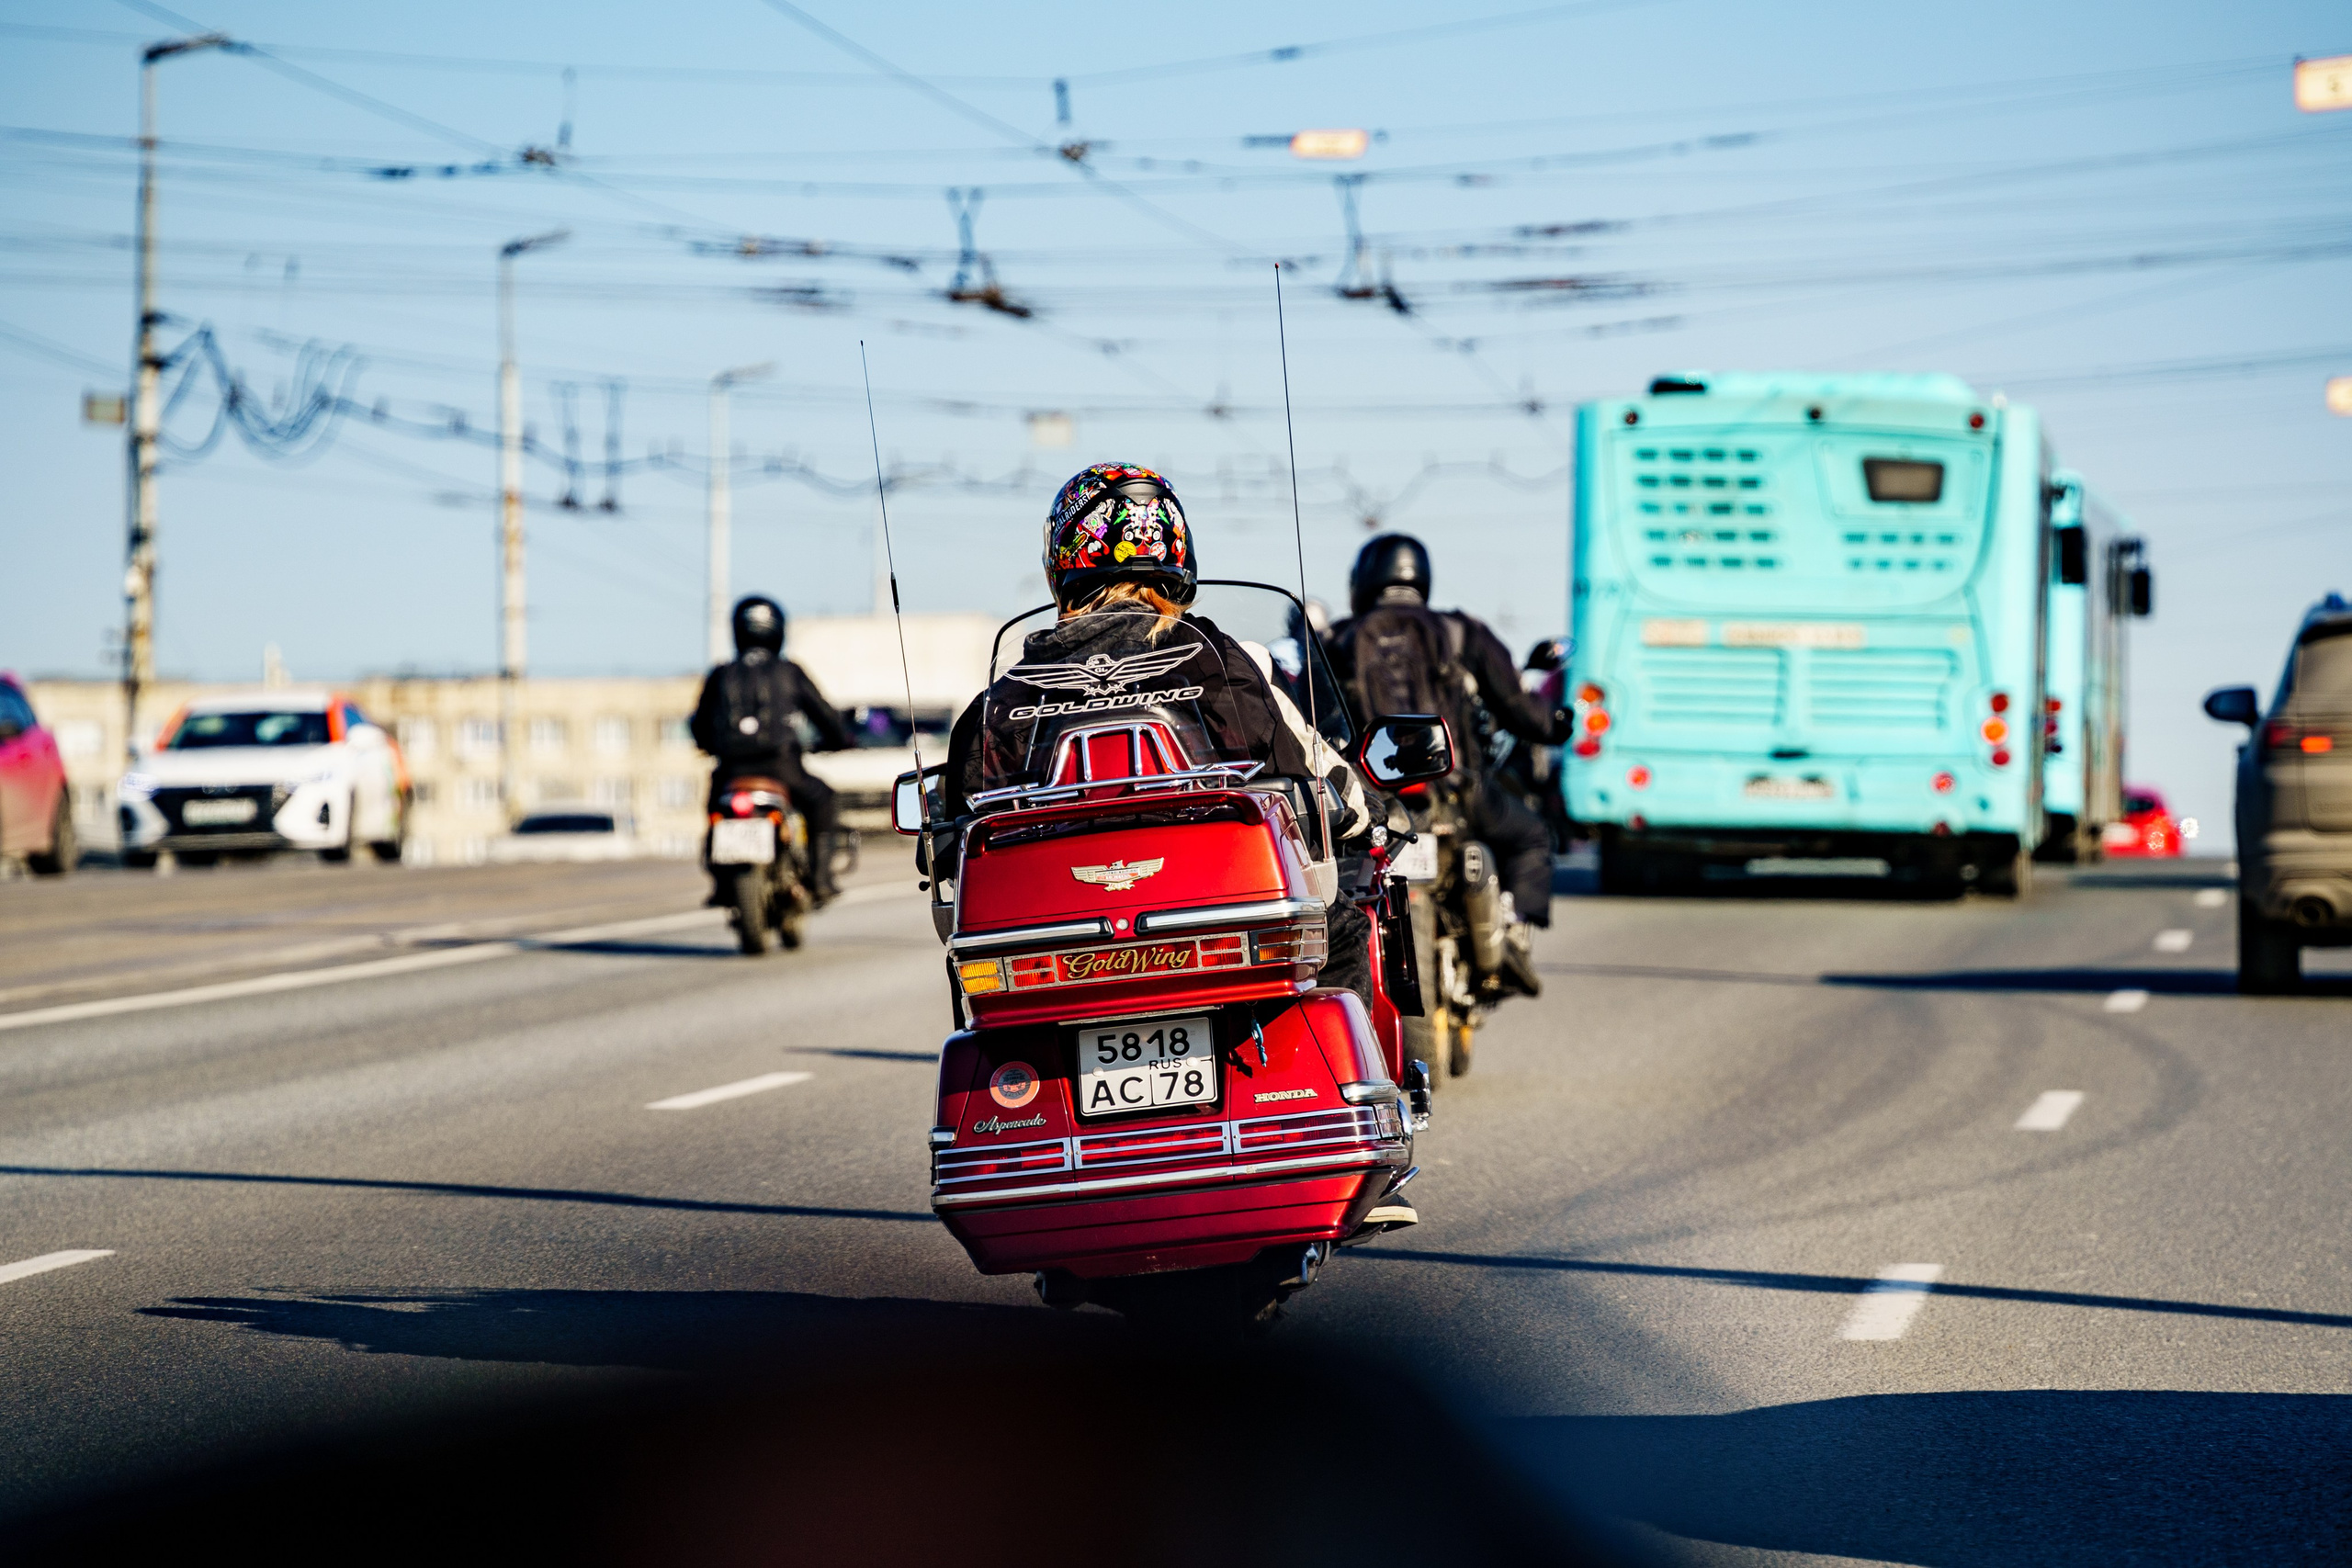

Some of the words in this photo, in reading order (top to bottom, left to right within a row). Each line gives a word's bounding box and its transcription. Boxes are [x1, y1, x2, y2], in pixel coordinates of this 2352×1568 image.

[1009, 686, 1204, 719] GOLDWING
[1097, 1027, 1190, 1064] 5818
[1148, 1057, 1182, 1070] RUS
[1091, 1077, 1145, 1109] AC
[1159, 1070, 1204, 1100] 78
[1253, 1089, 1318, 1103] HONDA
[974, 1112, 1046, 1135] Aspencade
